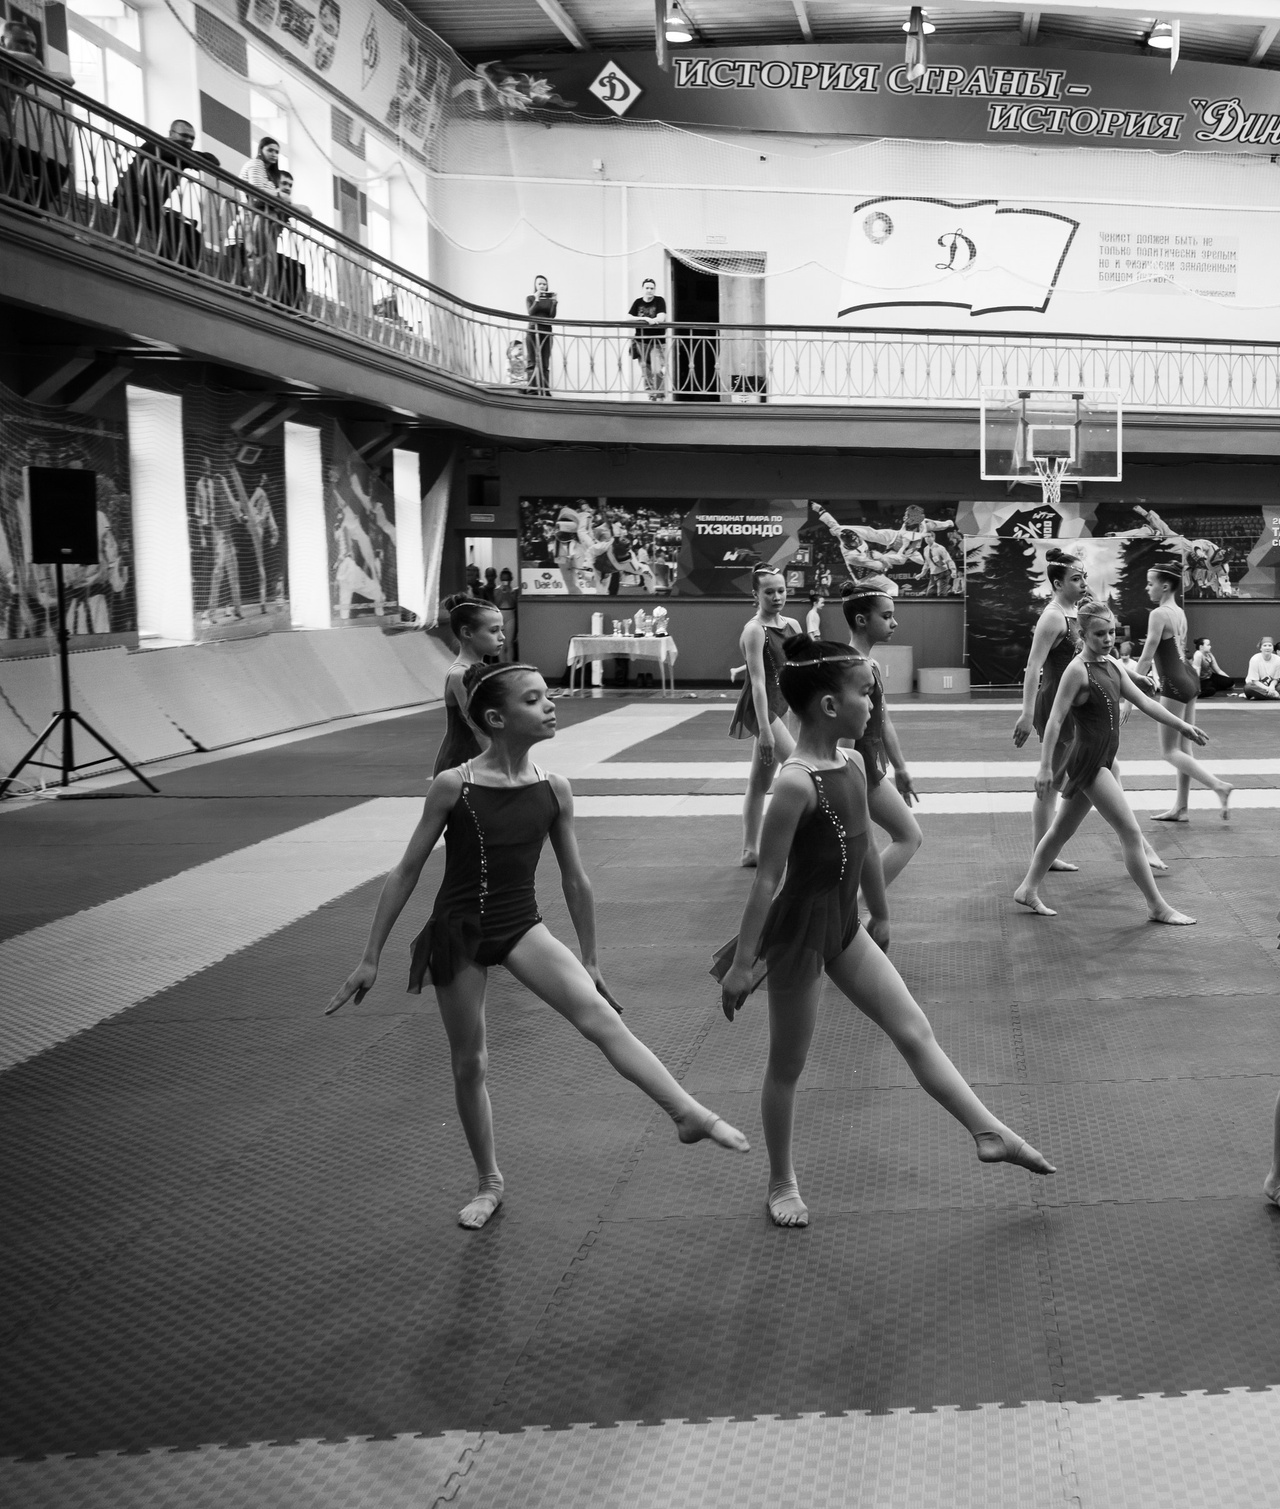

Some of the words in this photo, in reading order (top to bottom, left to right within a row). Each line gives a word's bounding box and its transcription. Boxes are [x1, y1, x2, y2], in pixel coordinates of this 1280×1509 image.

[673, 58, 881, 92] ИСТОРИЯ
[887, 65, 1065, 100] СТРАНЫ
[988, 103, 1186, 140] ИСТОРИЯ
[696, 524, 783, 537] ТХЭКВОНДО
